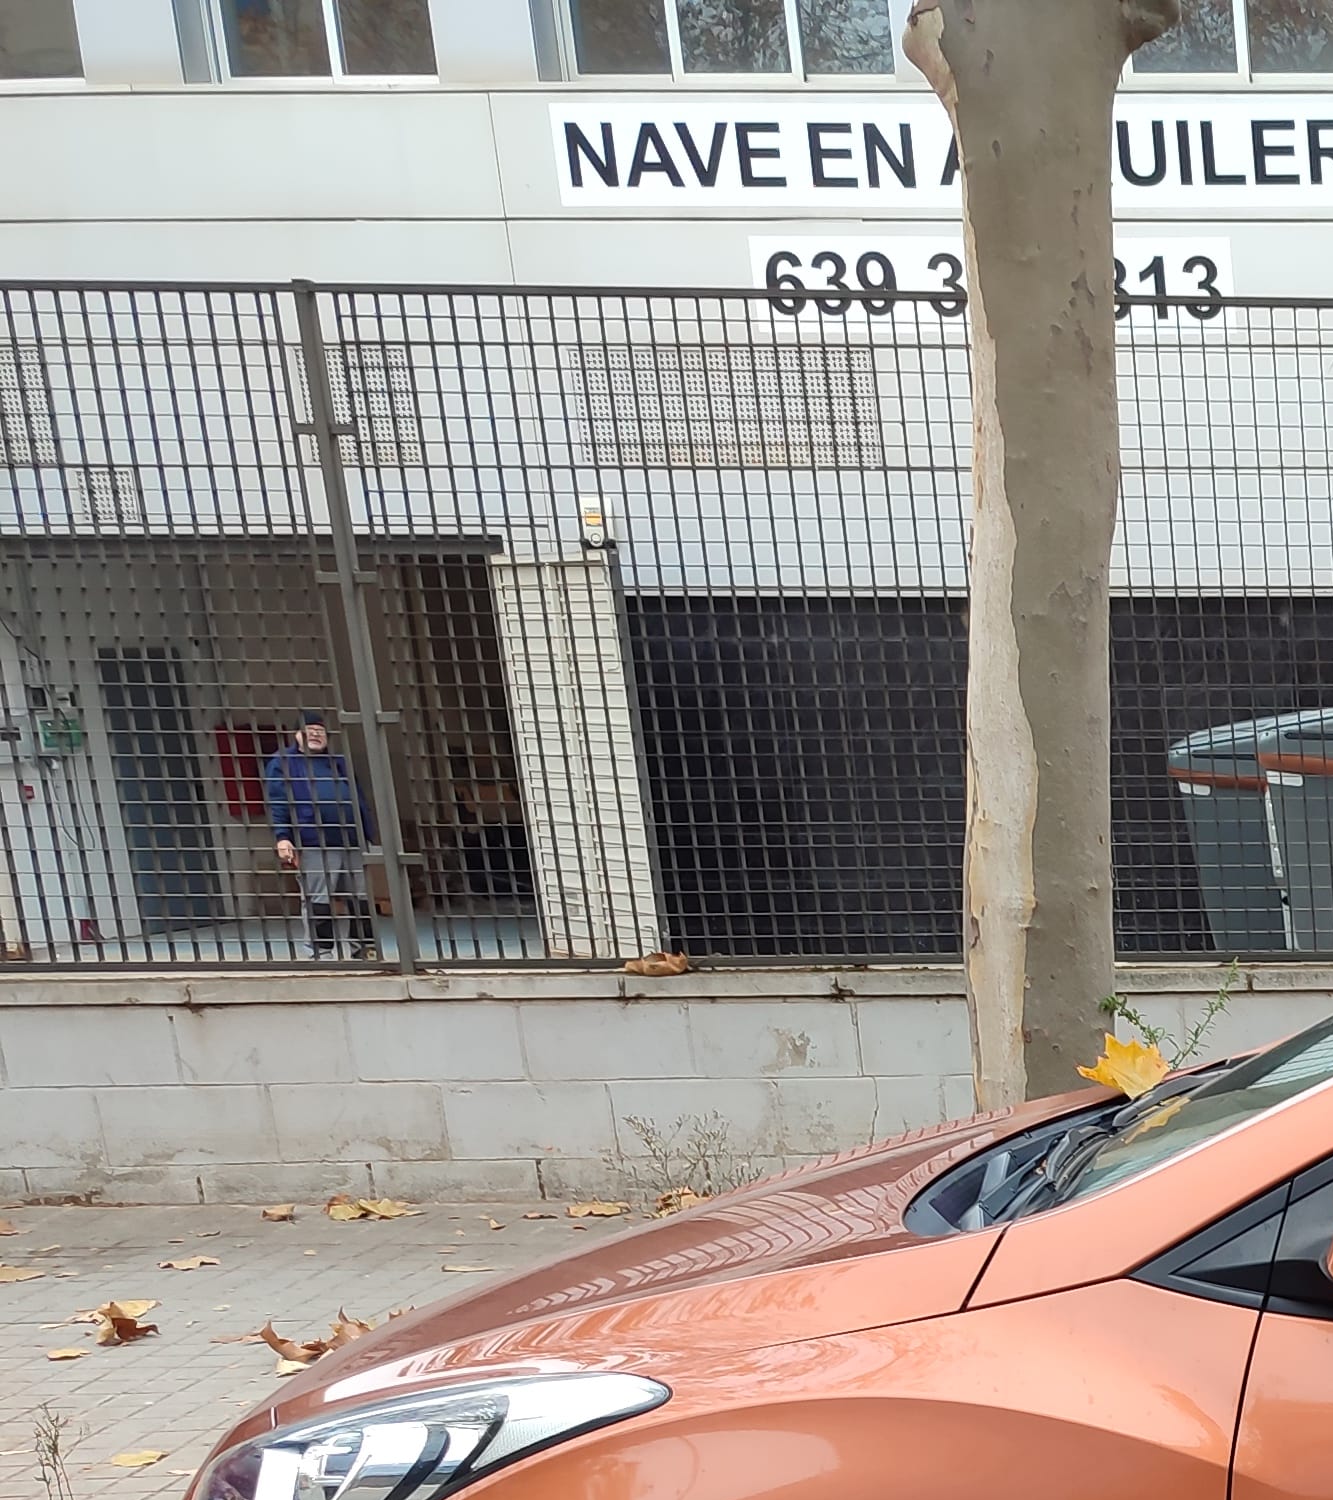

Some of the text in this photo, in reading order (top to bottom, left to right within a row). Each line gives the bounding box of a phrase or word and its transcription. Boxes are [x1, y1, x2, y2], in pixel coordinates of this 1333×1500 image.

[563, 121, 788, 188] NAVE
[806, 121, 917, 189] EN
[765, 250, 898, 316] 639
